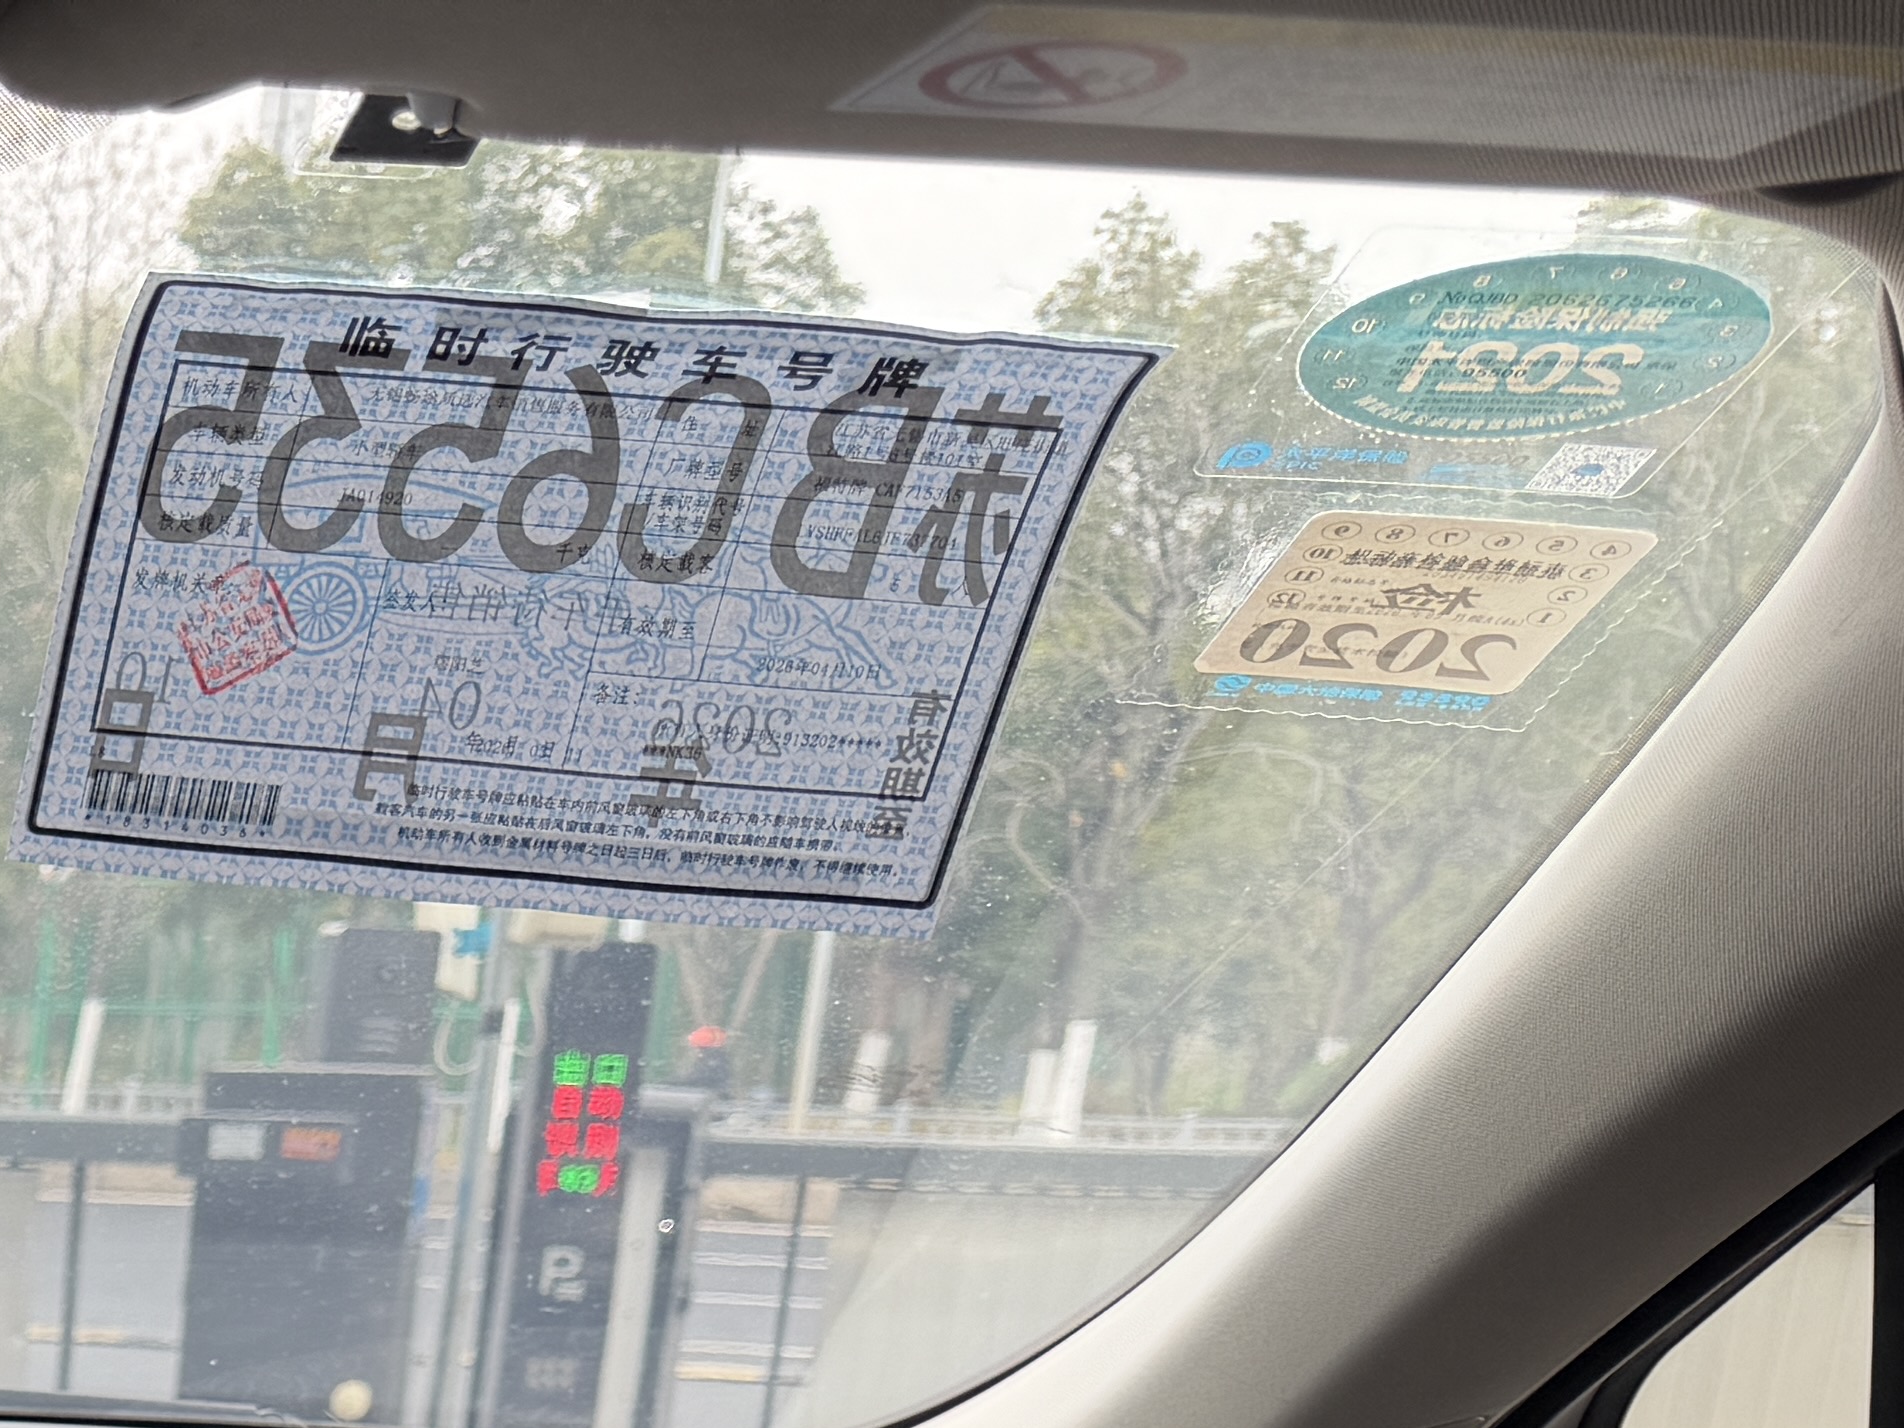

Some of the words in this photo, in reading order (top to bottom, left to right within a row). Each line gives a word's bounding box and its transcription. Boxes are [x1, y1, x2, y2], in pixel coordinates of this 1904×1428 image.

[339, 316, 930, 399] 临时行驶车号牌
[181, 378, 301, 404] 机动车所有人
[188, 423, 267, 447] 车辆类型
[663, 458, 743, 483] 厂牌型号
[171, 466, 265, 491] 发动机号码
[158, 511, 256, 537] 核定载质量
[638, 552, 715, 574] 核定载客
[615, 616, 696, 641] 有效期至
